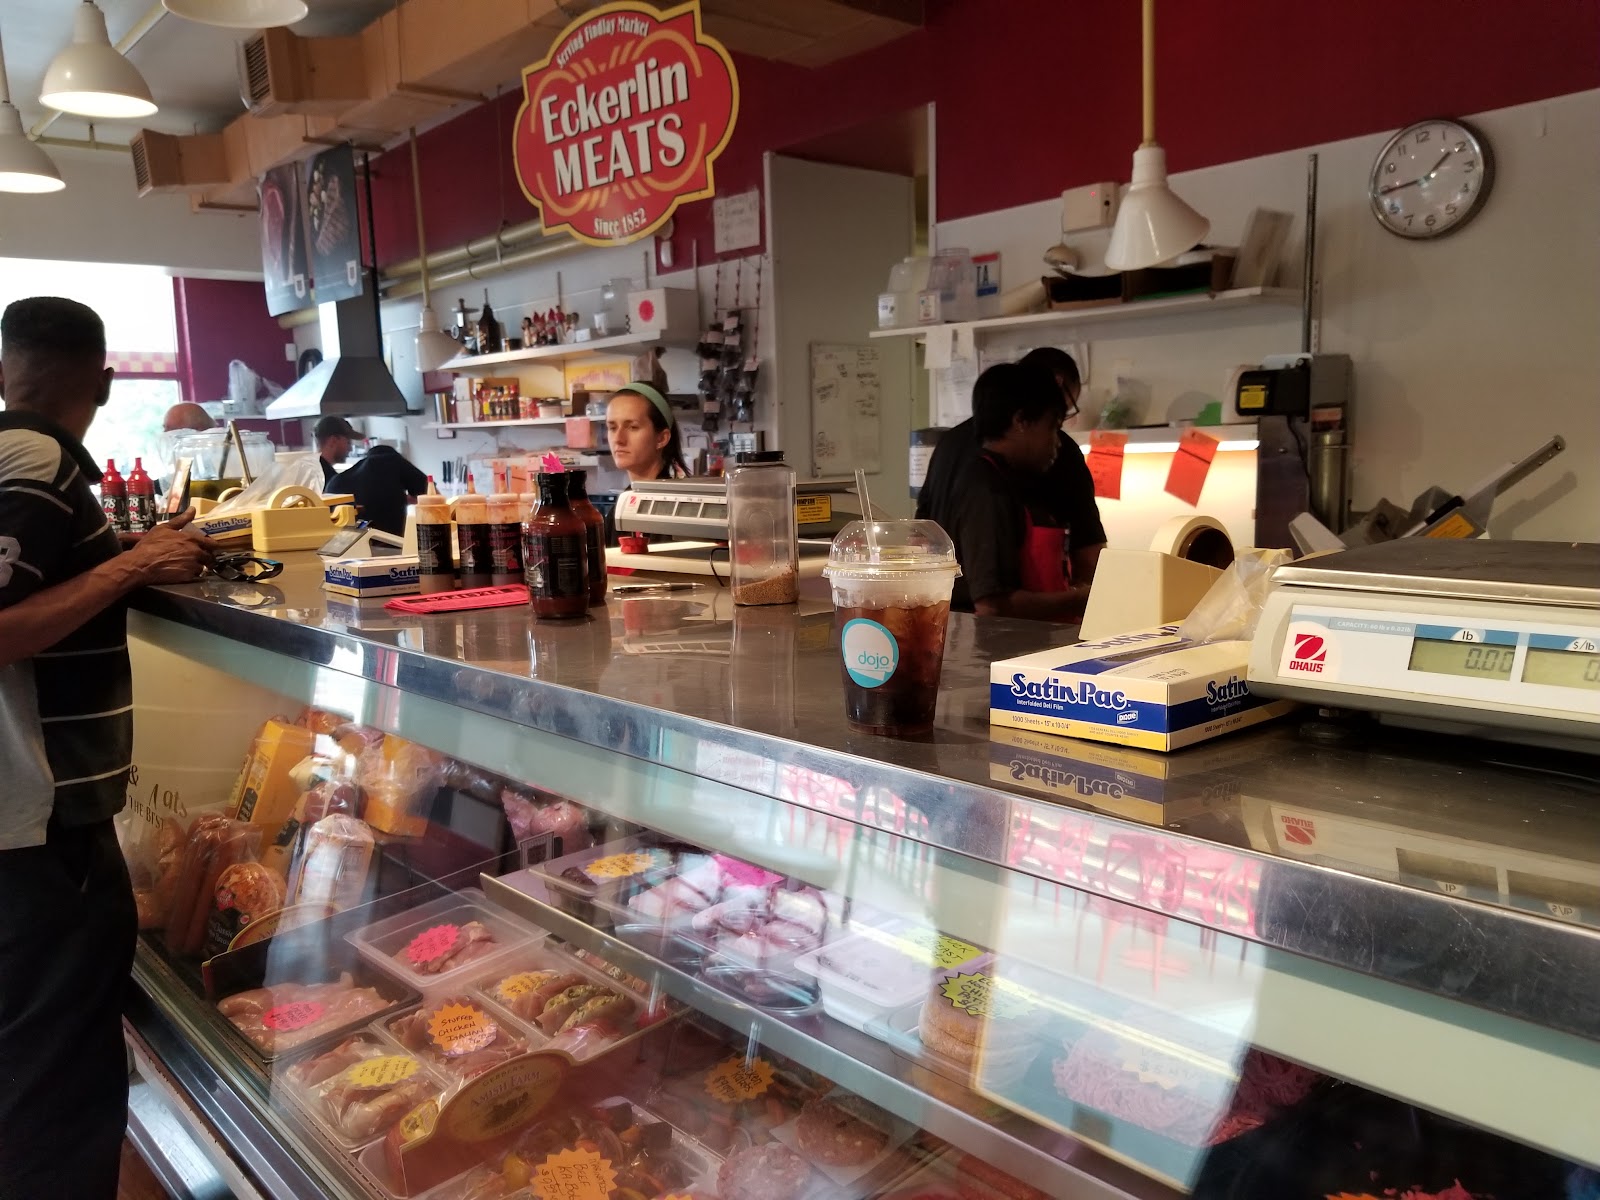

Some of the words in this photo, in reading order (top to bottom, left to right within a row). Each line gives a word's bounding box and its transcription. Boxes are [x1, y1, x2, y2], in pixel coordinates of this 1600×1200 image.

[556, 31, 584, 69] Serving
[584, 18, 616, 43] Findlay
[617, 15, 650, 38] Market
[540, 57, 690, 145] Eckerlin
[1415, 130, 1430, 144] 12
[552, 113, 686, 197] MEATS
[593, 216, 619, 236] Since
[621, 208, 648, 235] 1852
[1403, 214, 1415, 226] 7
[1424, 214, 1437, 227] 6
[205, 520, 231, 530] Satin
[1462, 631, 1474, 641] lb
[857, 650, 890, 670] dojo
[1289, 660, 1324, 674] OHAUS
[1010, 672, 1078, 704] Satin
[1078, 680, 1128, 710] Pac
[1206, 674, 1249, 705] Satin
[1016, 698, 1042, 708] Interfolded
[1012, 715, 1023, 723] 1000
[1024, 717, 1040, 725] Sheets
[441, 1014, 473, 1027] STUFFED
[438, 1021, 476, 1037] CHICKEN
[446, 1027, 484, 1042] ITALIAN
